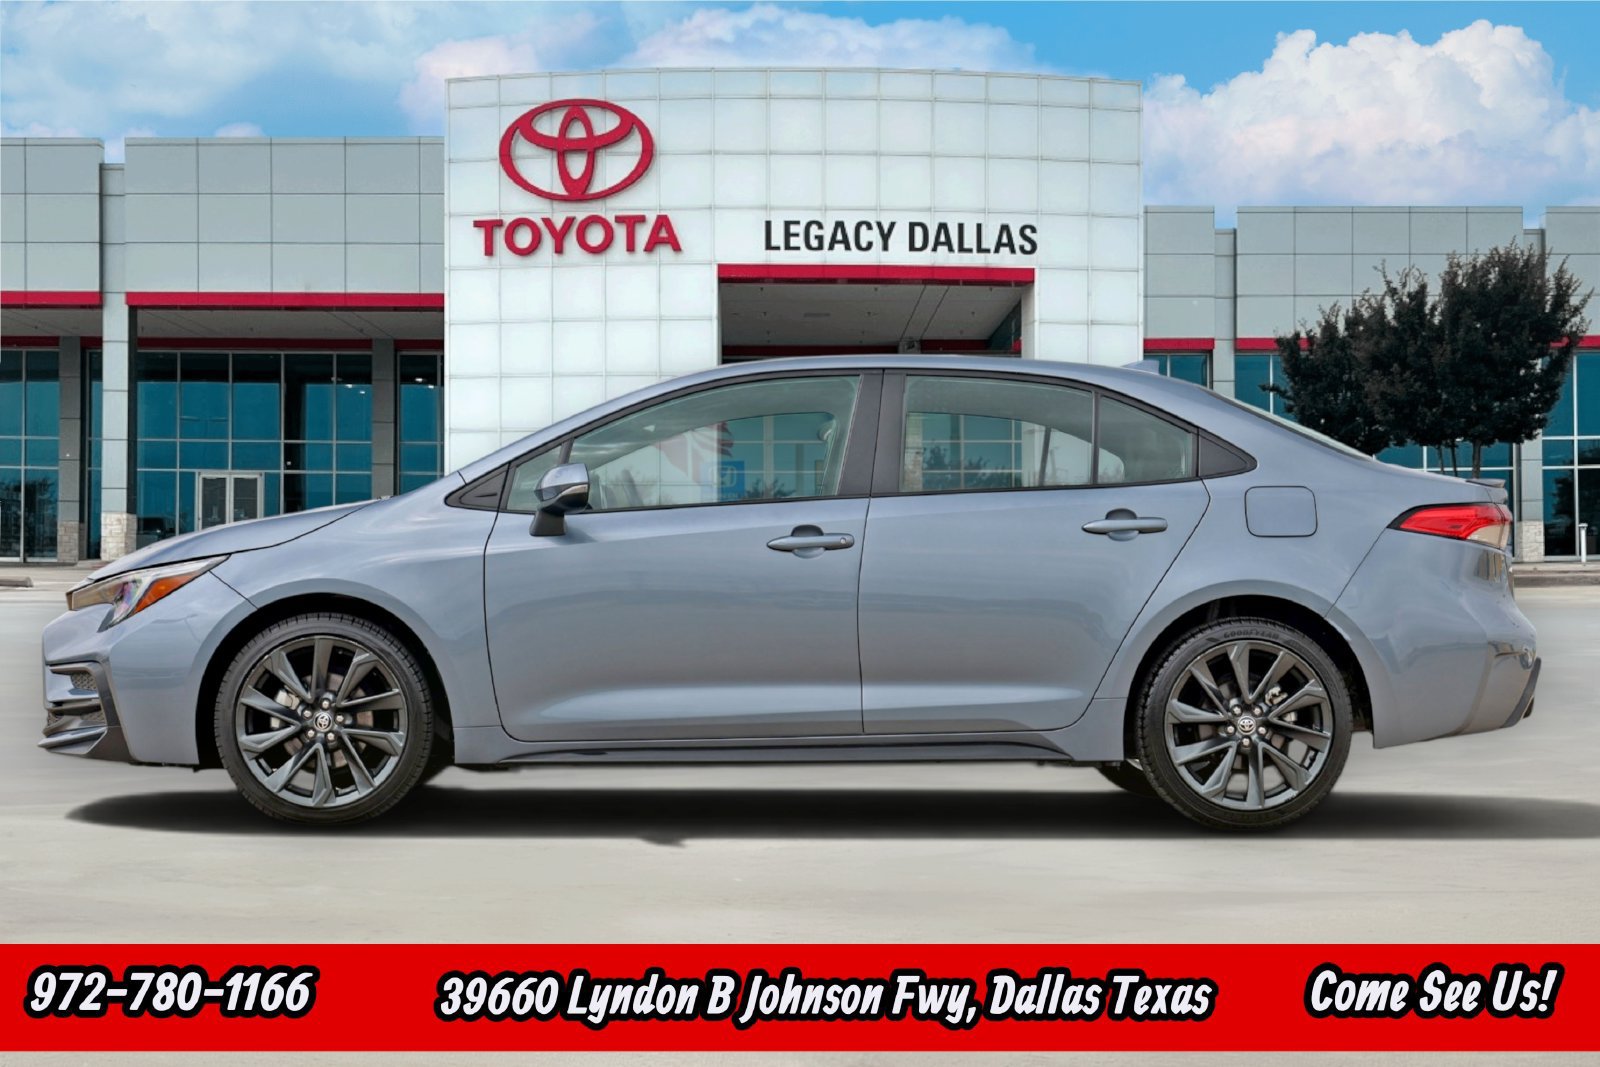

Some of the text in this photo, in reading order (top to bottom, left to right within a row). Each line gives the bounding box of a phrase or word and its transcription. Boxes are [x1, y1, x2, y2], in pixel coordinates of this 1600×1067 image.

[474, 214, 681, 256] TOYOTA
[765, 220, 1038, 255] LEGACY DALLAS
